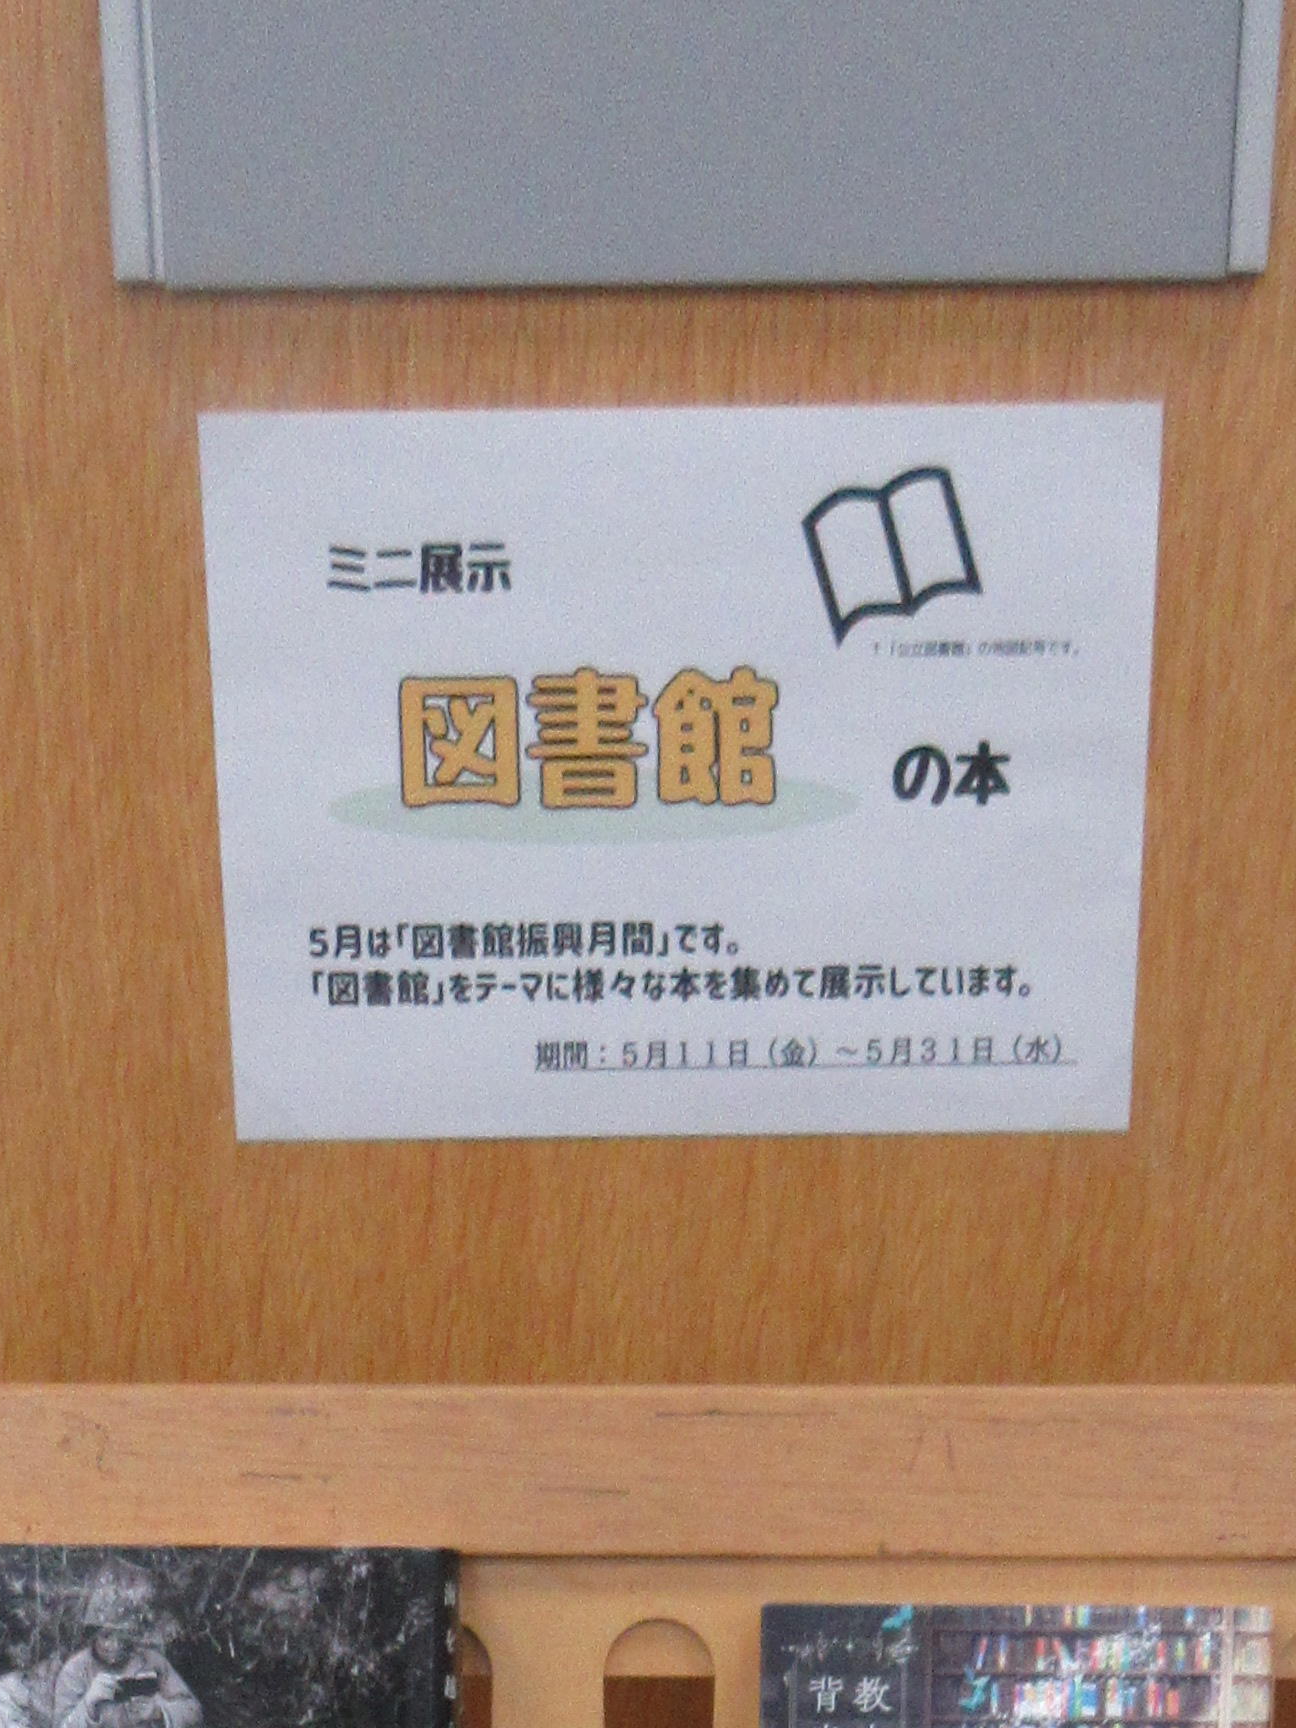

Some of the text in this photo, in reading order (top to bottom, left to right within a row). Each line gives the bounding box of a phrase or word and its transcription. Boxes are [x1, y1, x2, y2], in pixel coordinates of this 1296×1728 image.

[327, 542, 511, 593] ミニ展示
[398, 666, 780, 809] 図書館
[892, 741, 1011, 807] の本
[309, 923, 741, 961] 5月は「図書館振興月間」です。
[310, 965, 1035, 1006] 「図書館」をテーマに様々な本を集めて展示しています。
